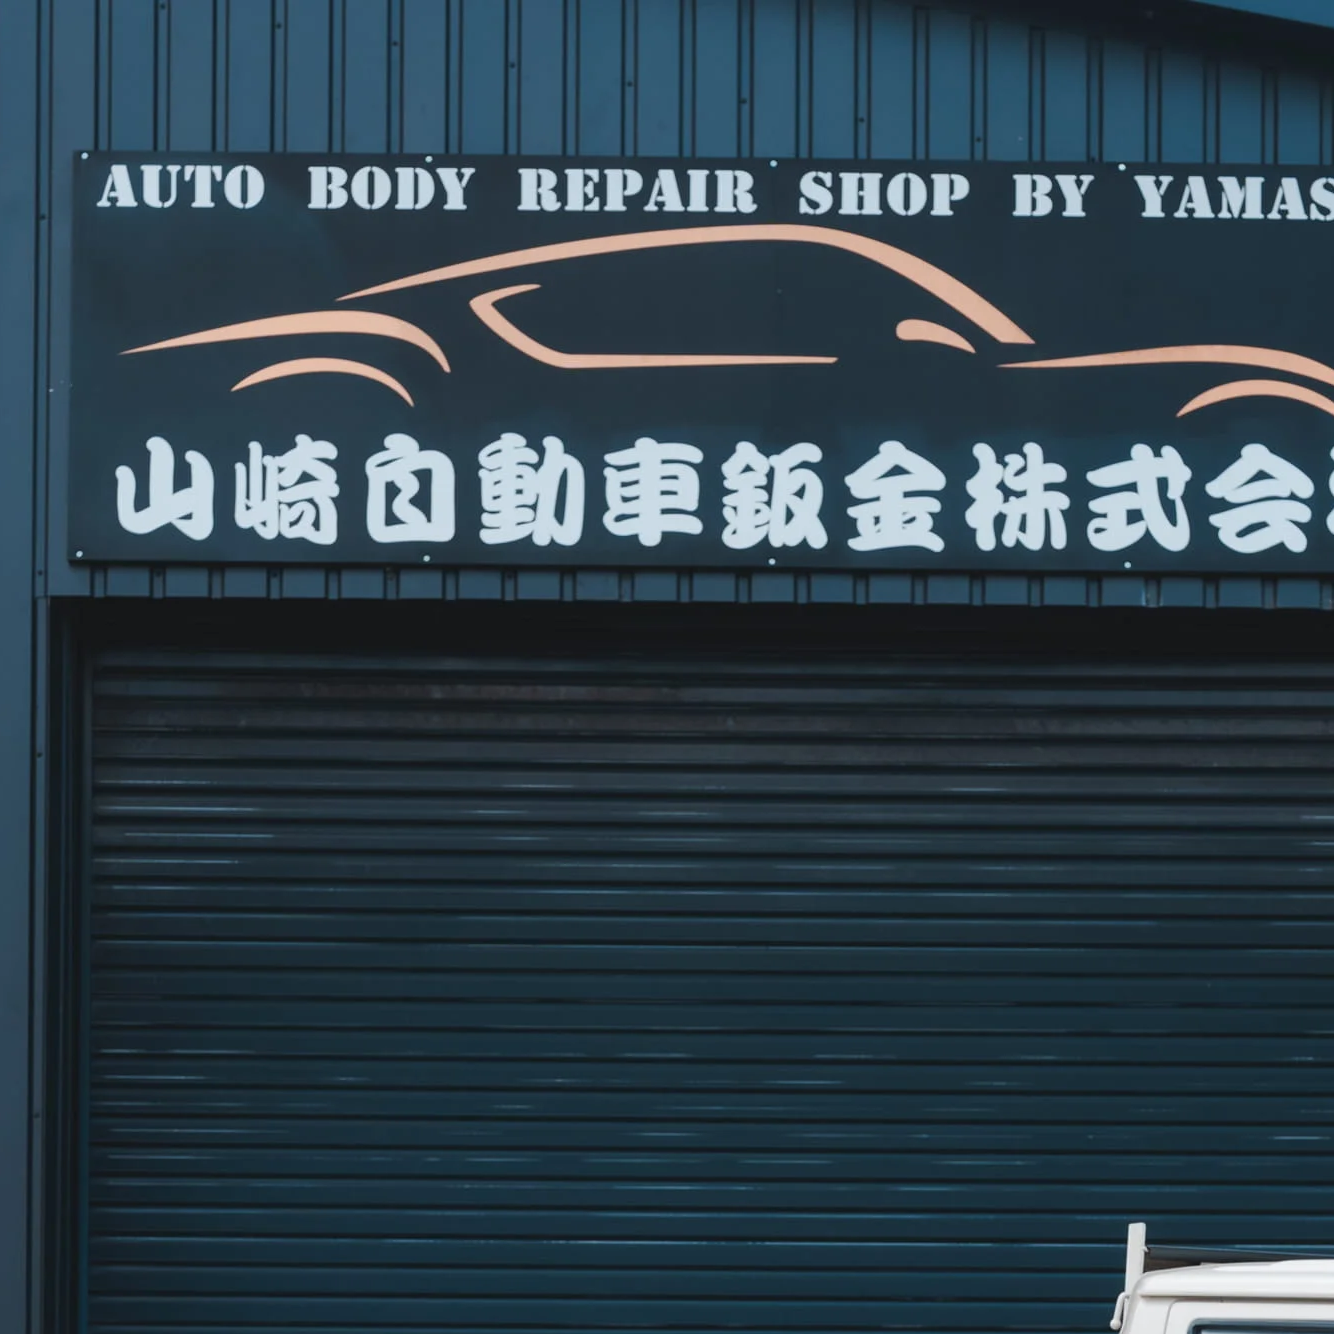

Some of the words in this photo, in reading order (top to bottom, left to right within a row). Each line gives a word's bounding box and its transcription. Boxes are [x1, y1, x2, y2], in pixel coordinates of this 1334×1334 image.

[97, 164, 265, 209] AUTO
[307, 166, 476, 210] BODY
[517, 168, 758, 214] REPAIR
[799, 171, 970, 216] SHOP
[1012, 174, 1095, 217] BY
